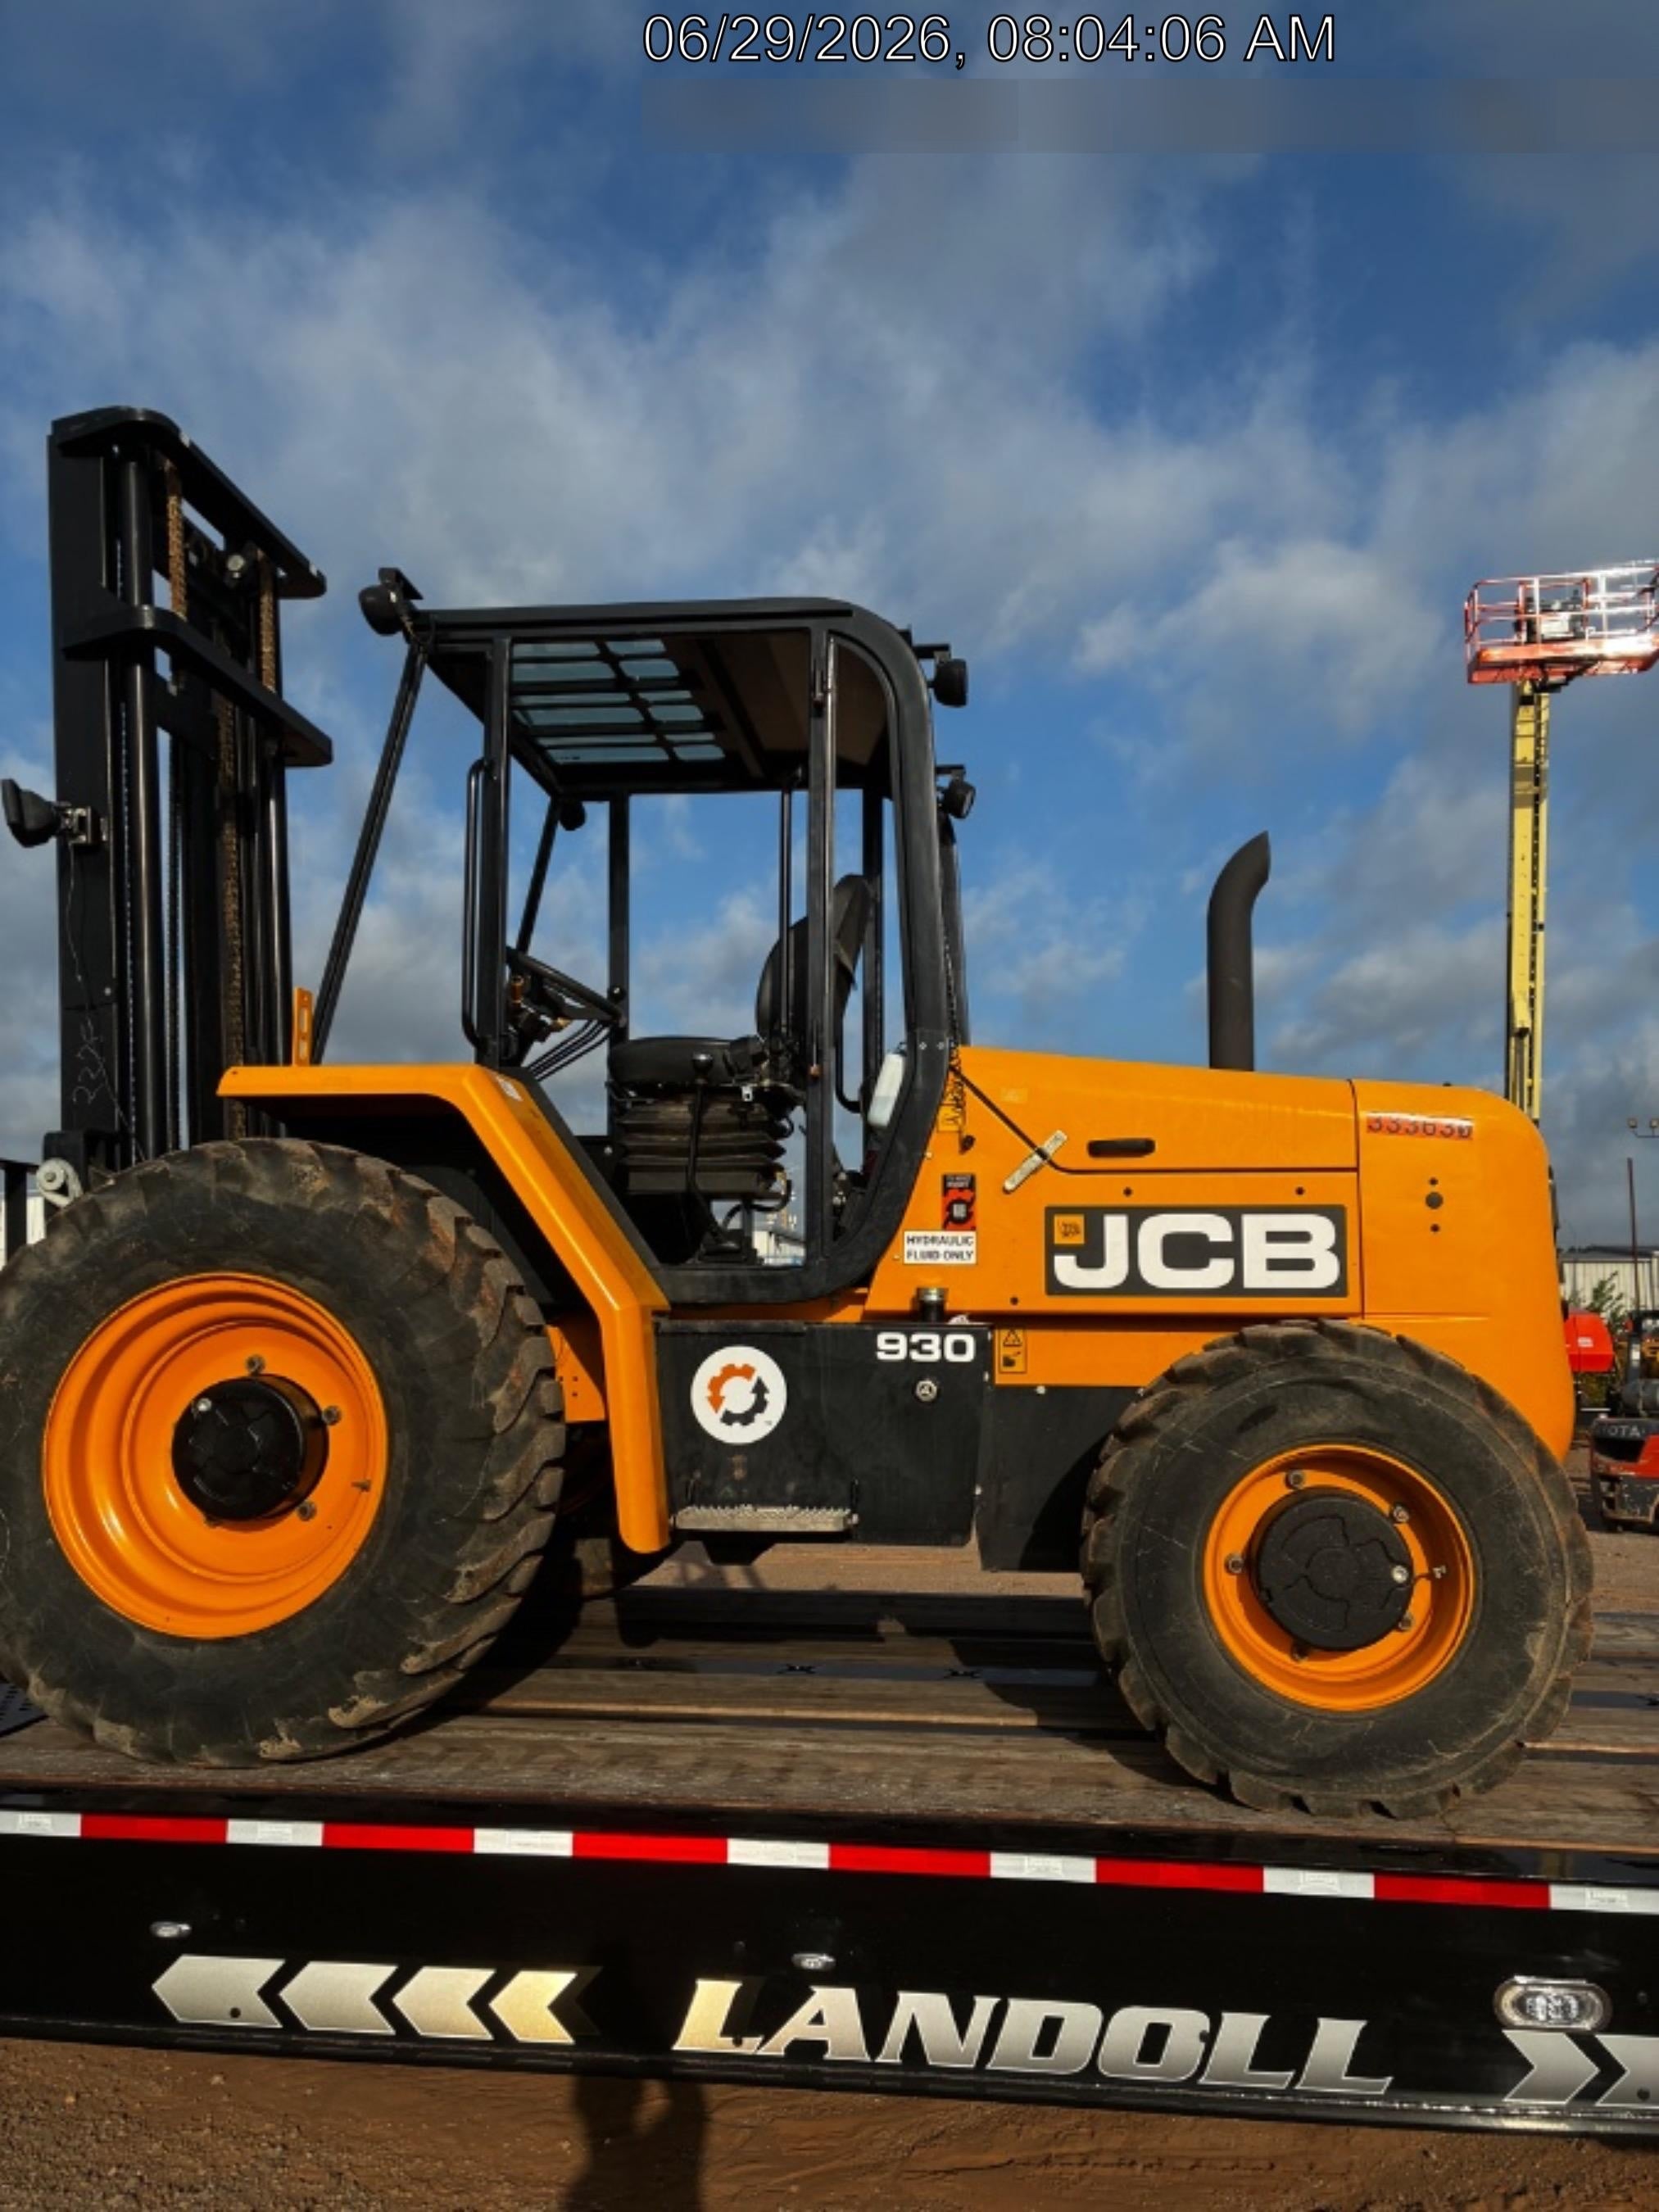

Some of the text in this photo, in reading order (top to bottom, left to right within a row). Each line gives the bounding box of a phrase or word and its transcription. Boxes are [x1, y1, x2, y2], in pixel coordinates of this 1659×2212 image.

[906, 1235, 974, 1245] HYDRAULIC
[907, 1250, 974, 1260] FLUID ONLY
[1054, 1213, 1339, 1289] JCB
[876, 1332, 976, 1362] 930
[670, 1978, 1394, 2096] LANDOLL
